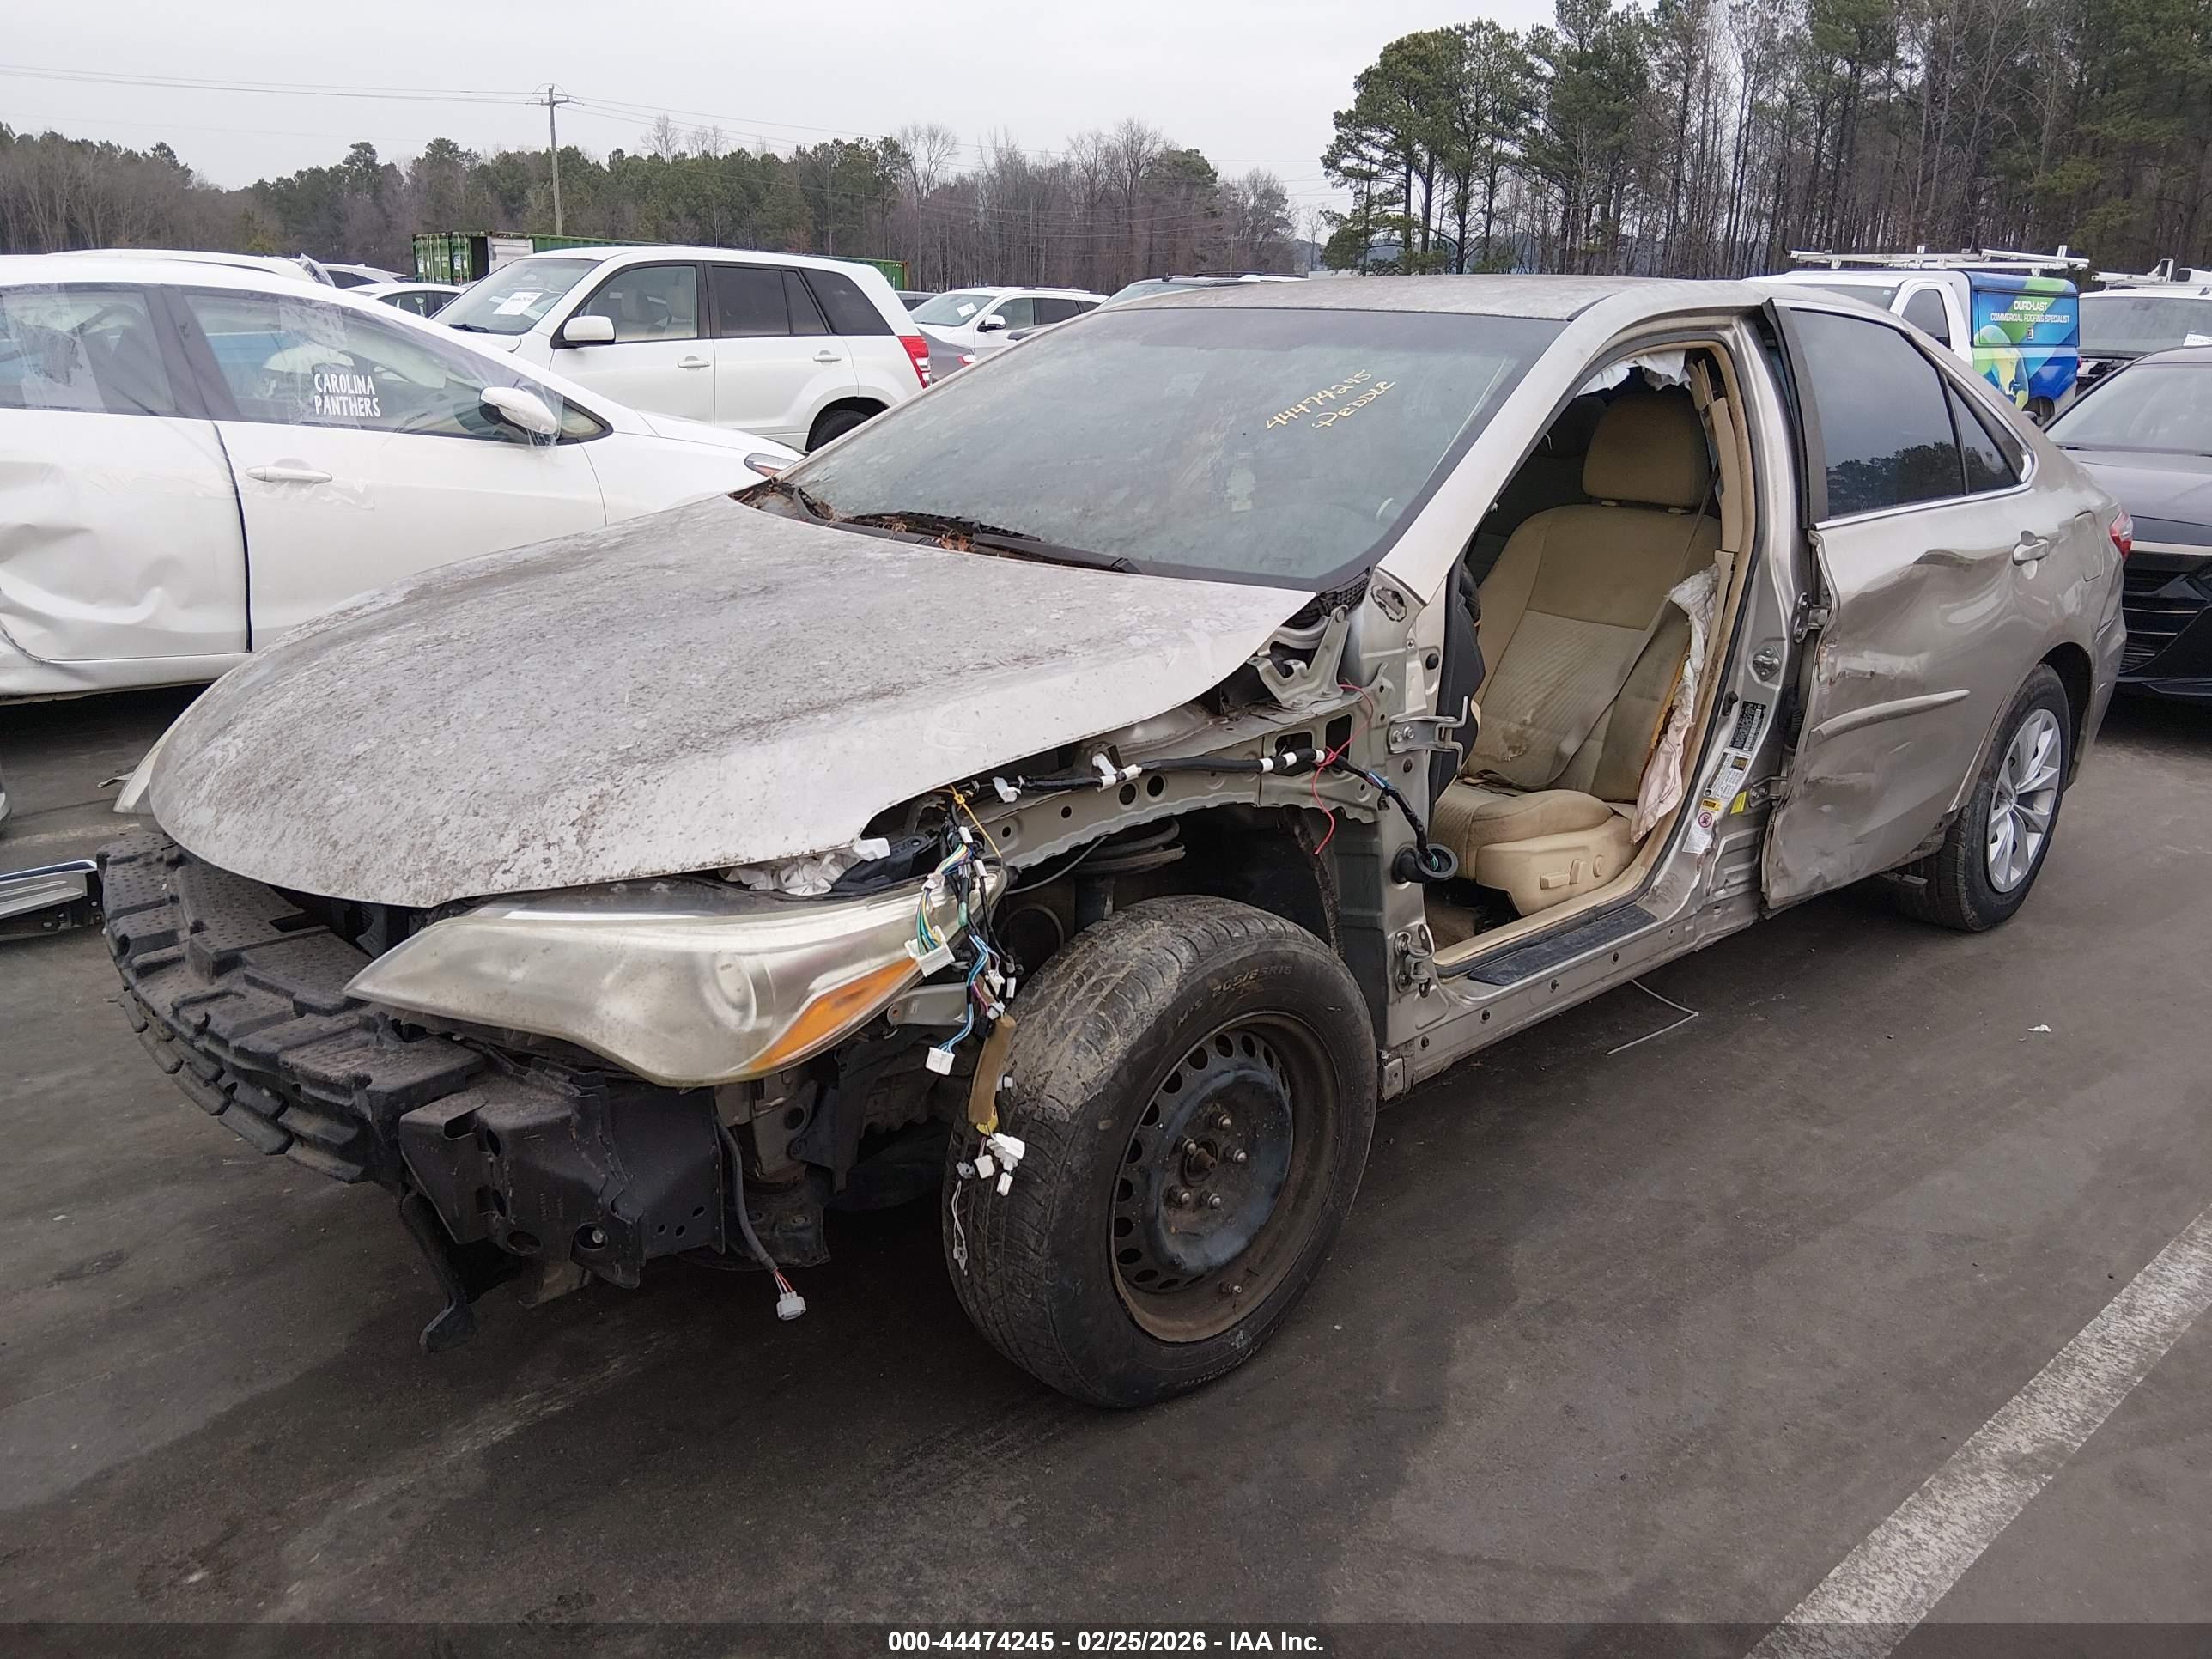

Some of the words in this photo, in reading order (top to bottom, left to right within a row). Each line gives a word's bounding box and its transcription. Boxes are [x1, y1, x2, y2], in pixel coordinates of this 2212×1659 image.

[1990, 313, 2023, 323] COMMERCIAL
[2023, 313, 2045, 324] ROOFING
[2045, 314, 2070, 324] SPECIALIST
[314, 373, 376, 395] CAROLINA
[314, 395, 381, 418] PANTHERS
[1266, 368, 1372, 429] 44474245
